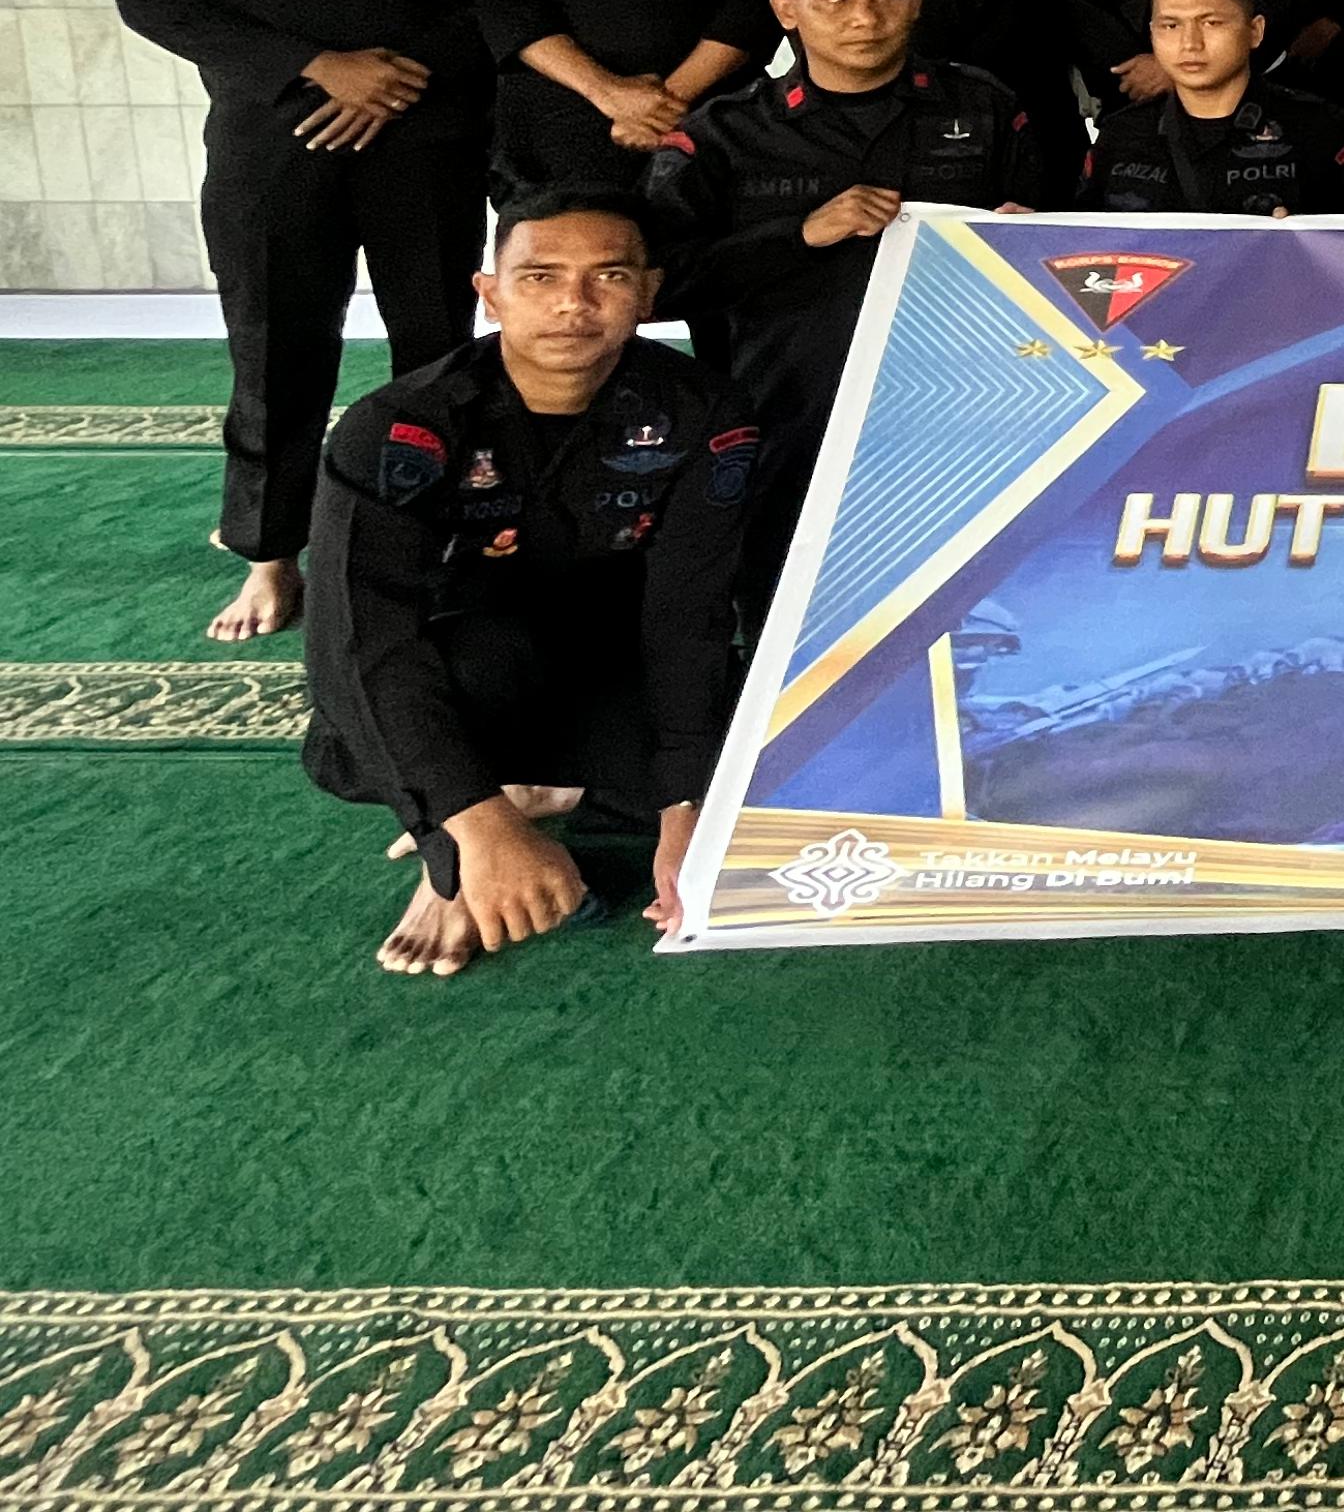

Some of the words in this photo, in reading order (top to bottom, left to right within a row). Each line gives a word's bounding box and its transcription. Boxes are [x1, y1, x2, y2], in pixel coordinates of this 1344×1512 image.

[1226, 162, 1296, 186] POLRI
[1063, 847, 1198, 872] Melayu
[914, 869, 1036, 893] Hilang
[1045, 870, 1093, 889] Di
[1095, 867, 1195, 888] Bumi
